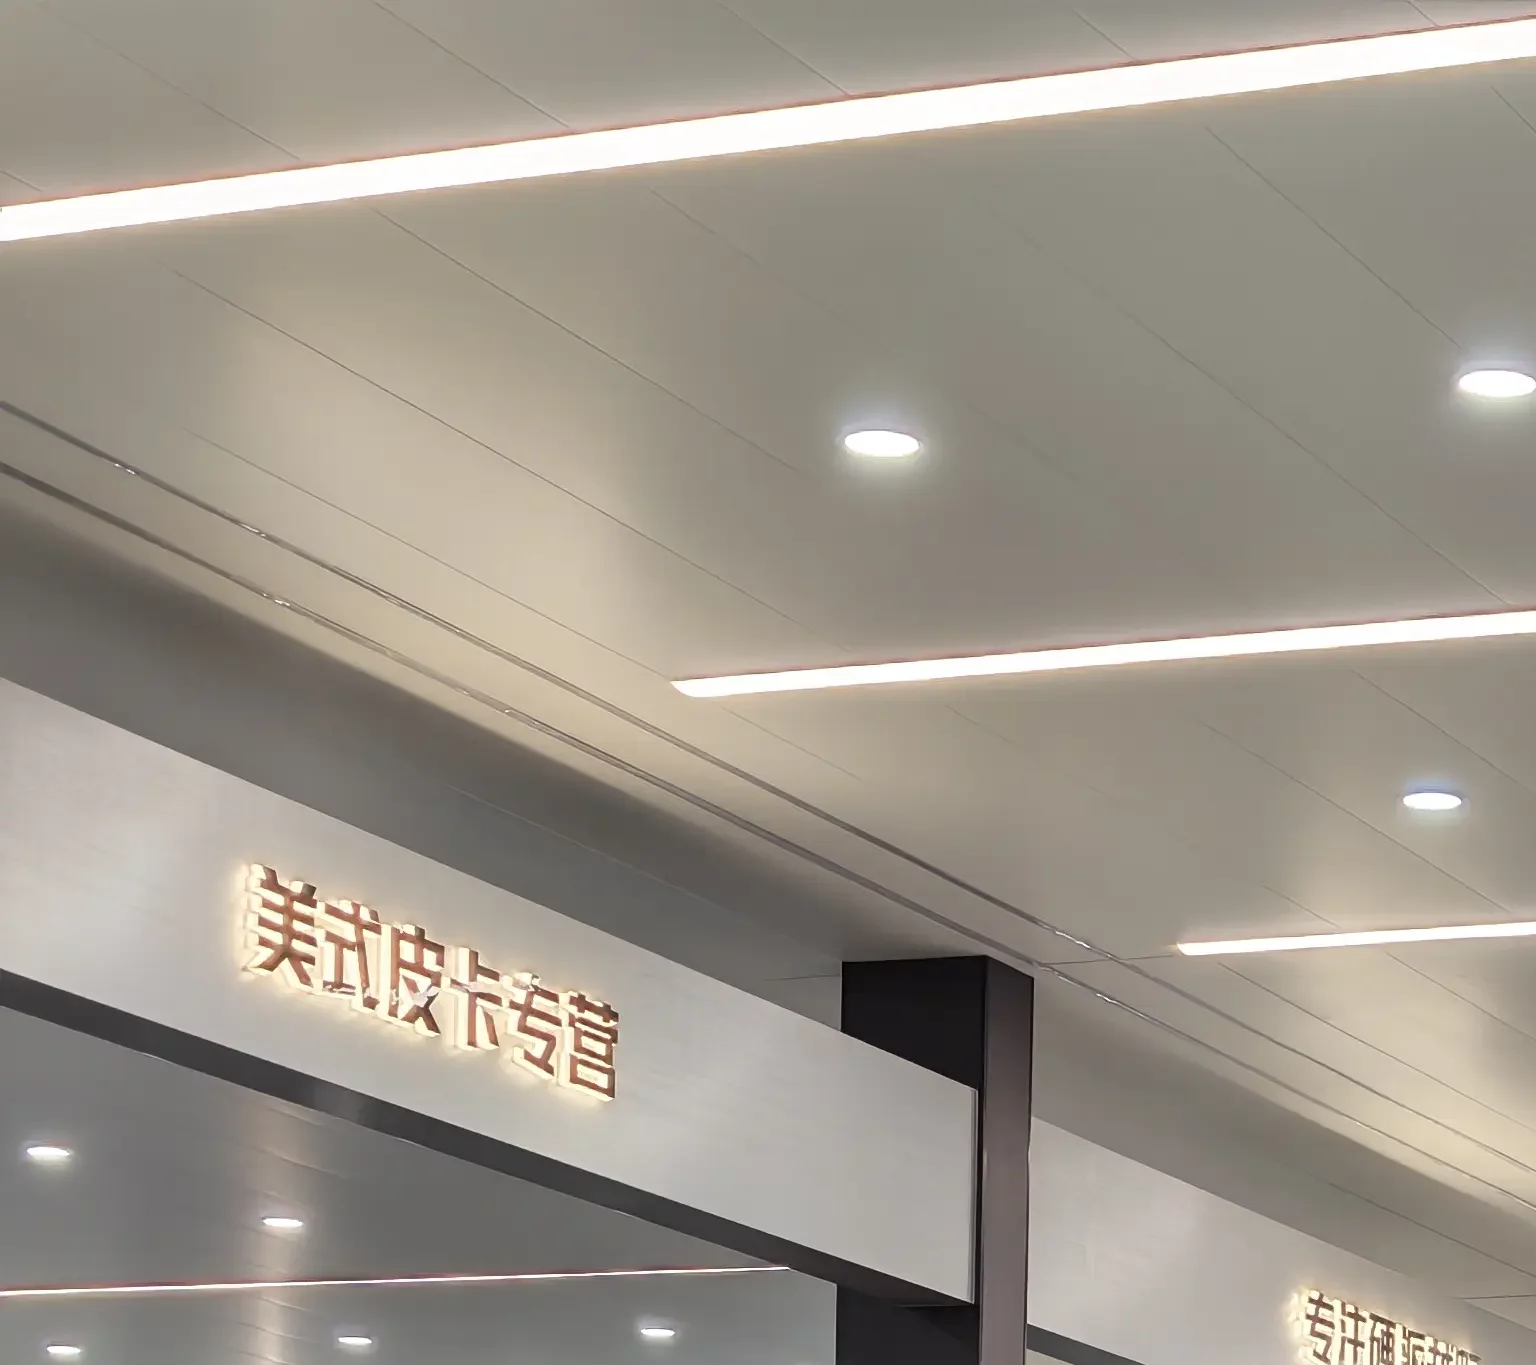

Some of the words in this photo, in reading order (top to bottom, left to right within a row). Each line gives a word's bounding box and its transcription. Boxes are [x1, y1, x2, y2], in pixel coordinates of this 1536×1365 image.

[244, 863, 619, 1101] 美式皮卡专营
